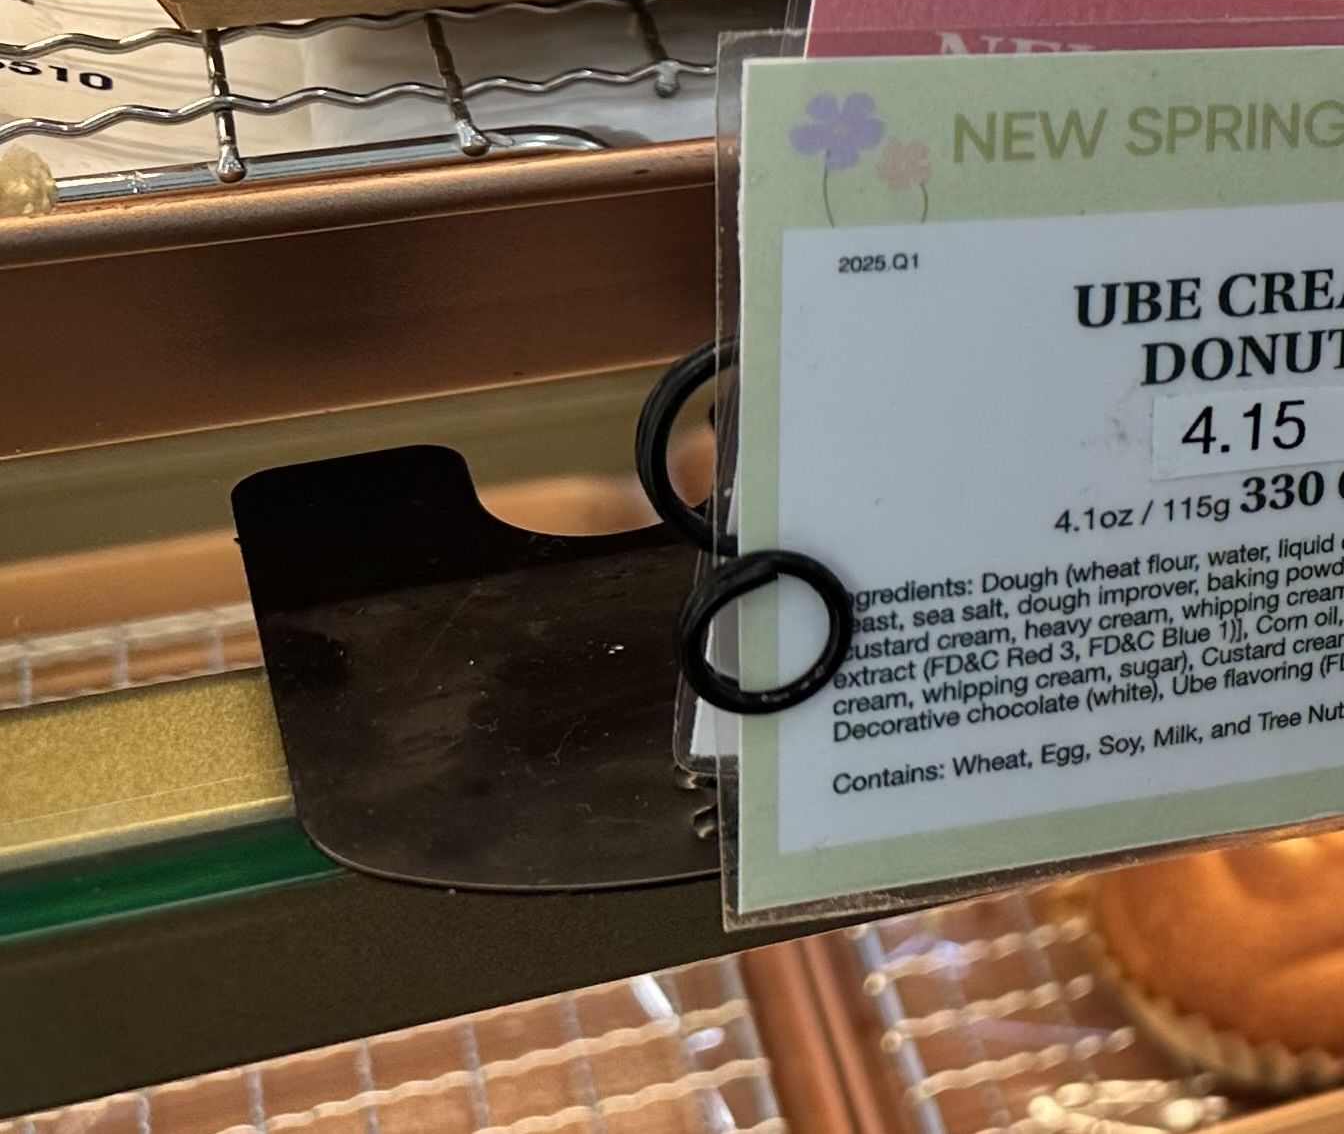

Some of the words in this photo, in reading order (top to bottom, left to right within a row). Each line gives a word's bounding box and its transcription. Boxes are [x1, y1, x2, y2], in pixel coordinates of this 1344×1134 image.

[0, 61, 113, 91] 510
[952, 108, 1107, 164] NEW
[838, 253, 920, 274] 2025.Q1
[1073, 276, 1202, 328] UBE
[1181, 400, 1306, 454] 4.15
[1054, 506, 1134, 533] 4.1oz
[1141, 499, 1154, 526] /
[1163, 496, 1231, 523] 115g
[1240, 470, 1325, 514] 330
[847, 577, 973, 612] ngredients:
[981, 566, 1058, 594] Dough
[1066, 556, 1141, 588] (wheat
[1147, 553, 1199, 575] flour,
[1207, 544, 1271, 567] water,
[1278, 532, 1335, 561] liquid
[851, 610, 904, 634] east,
[912, 607, 955, 628] sea
[961, 598, 1009, 621] salt,
[1017, 588, 1090, 615] dough
[1098, 578, 1199, 607] improver,
[1207, 567, 1279, 592] baking
[832, 659, 917, 690] extract
[922, 649, 999, 682] (FD&C
[1007, 642, 1053, 668] Red
[1060, 640, 1081, 663] 3,
[1089, 630, 1155, 658] FD&C
[1162, 626, 1211, 648] Blue
[1219, 617, 1248, 644] 1)],
[1256, 614, 1308, 635] Corn
[1315, 606, 1343, 627] oil,
[937, 626, 1016, 650] cream,
[1024, 617, 1092, 640] heavy
[1098, 607, 1174, 630] cream,
[1182, 592, 1279, 620] whipping
[832, 690, 914, 716] cream,
[922, 675, 1028, 705] whipping
[1036, 665, 1112, 690] cream,
[1119, 650, 1193, 679] sugar),
[1201, 638, 1286, 667] Custard
[832, 710, 961, 743] Decorative
[967, 693, 1080, 724] chocolate
[1086, 678, 1164, 712] (white),
[1172, 674, 1217, 696] Ube
[1224, 661, 1313, 689] flavoring
[832, 763, 945, 796] Contains:
[952, 749, 1033, 777] Wheat,
[1041, 742, 1091, 767] Egg,
[1099, 734, 1146, 756] Soy,
[1153, 723, 1203, 748] Milk,
[1210, 714, 1251, 739] and
[1258, 709, 1301, 732] Tree
